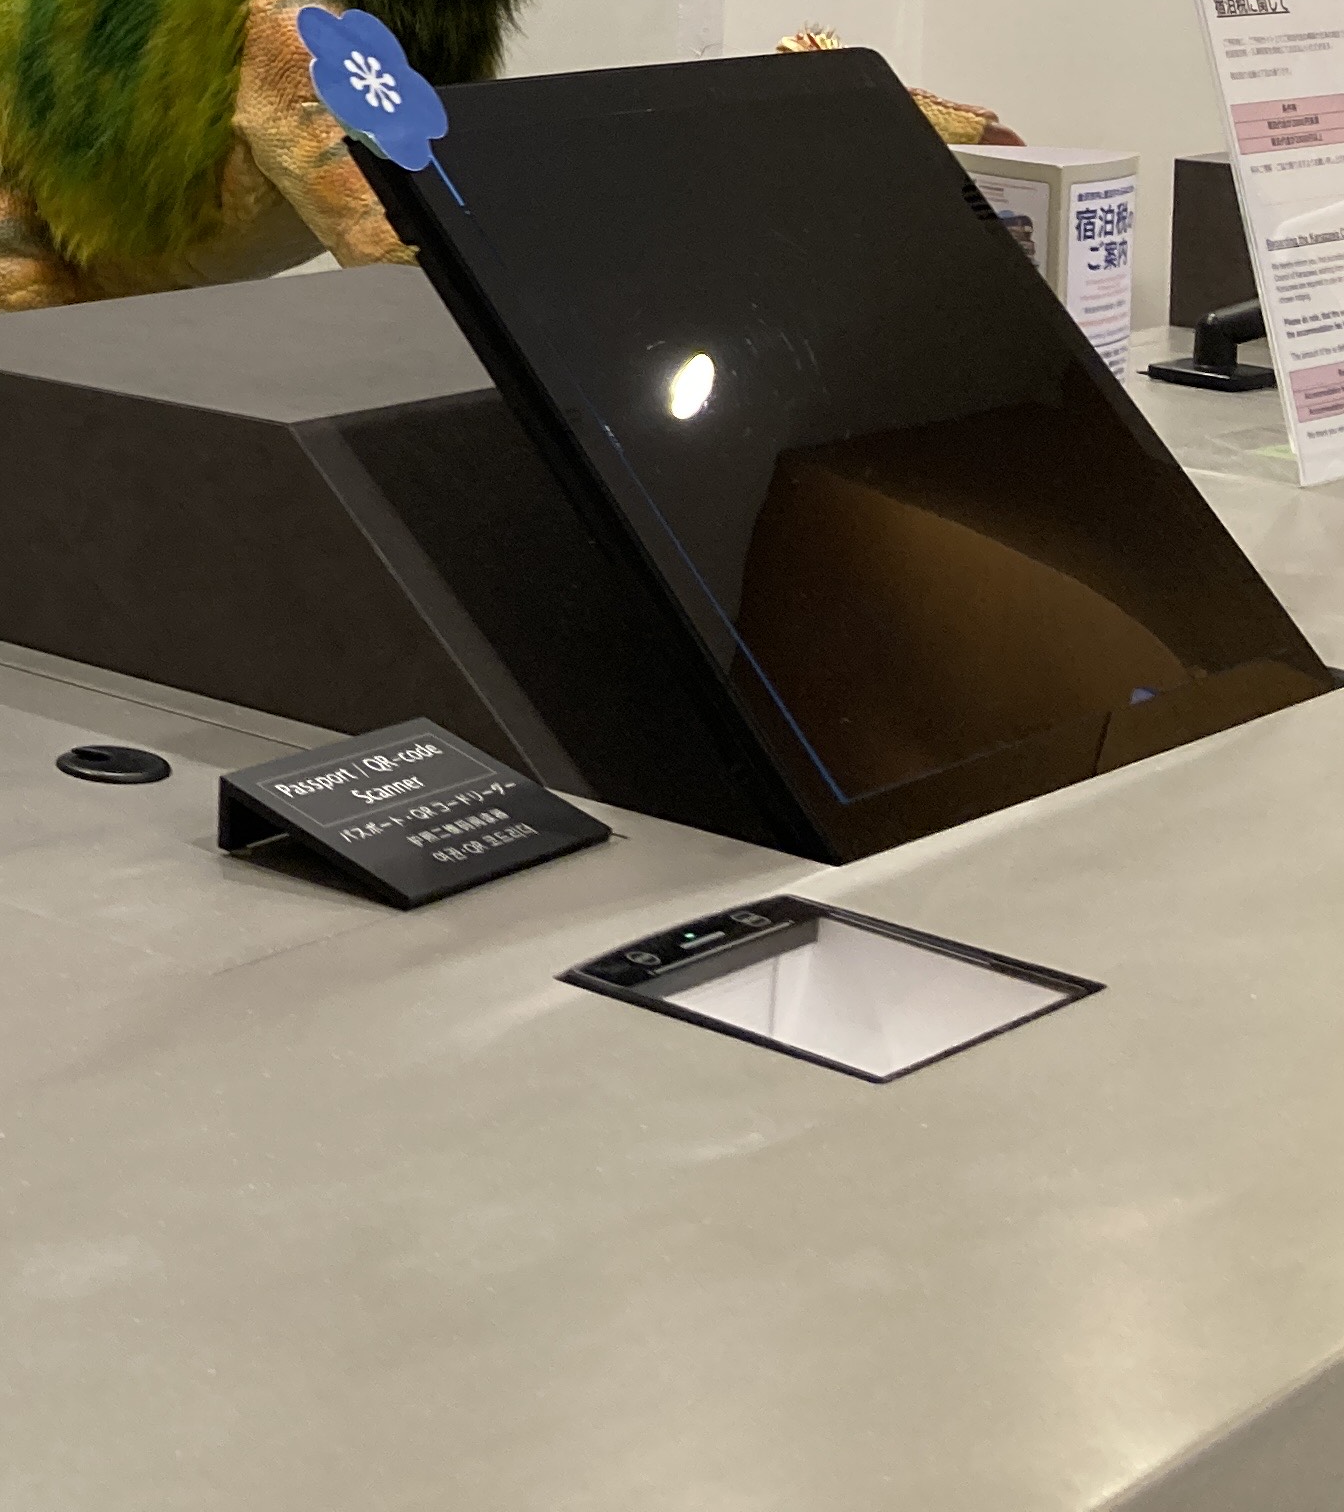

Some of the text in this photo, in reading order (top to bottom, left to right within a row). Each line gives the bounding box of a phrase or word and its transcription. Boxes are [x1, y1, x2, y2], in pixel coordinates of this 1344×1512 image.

[1087, 238, 1128, 270] ご案内
[274, 768, 359, 799] Passport
[362, 743, 444, 772] QR-code
[350, 775, 426, 804] Scanner
